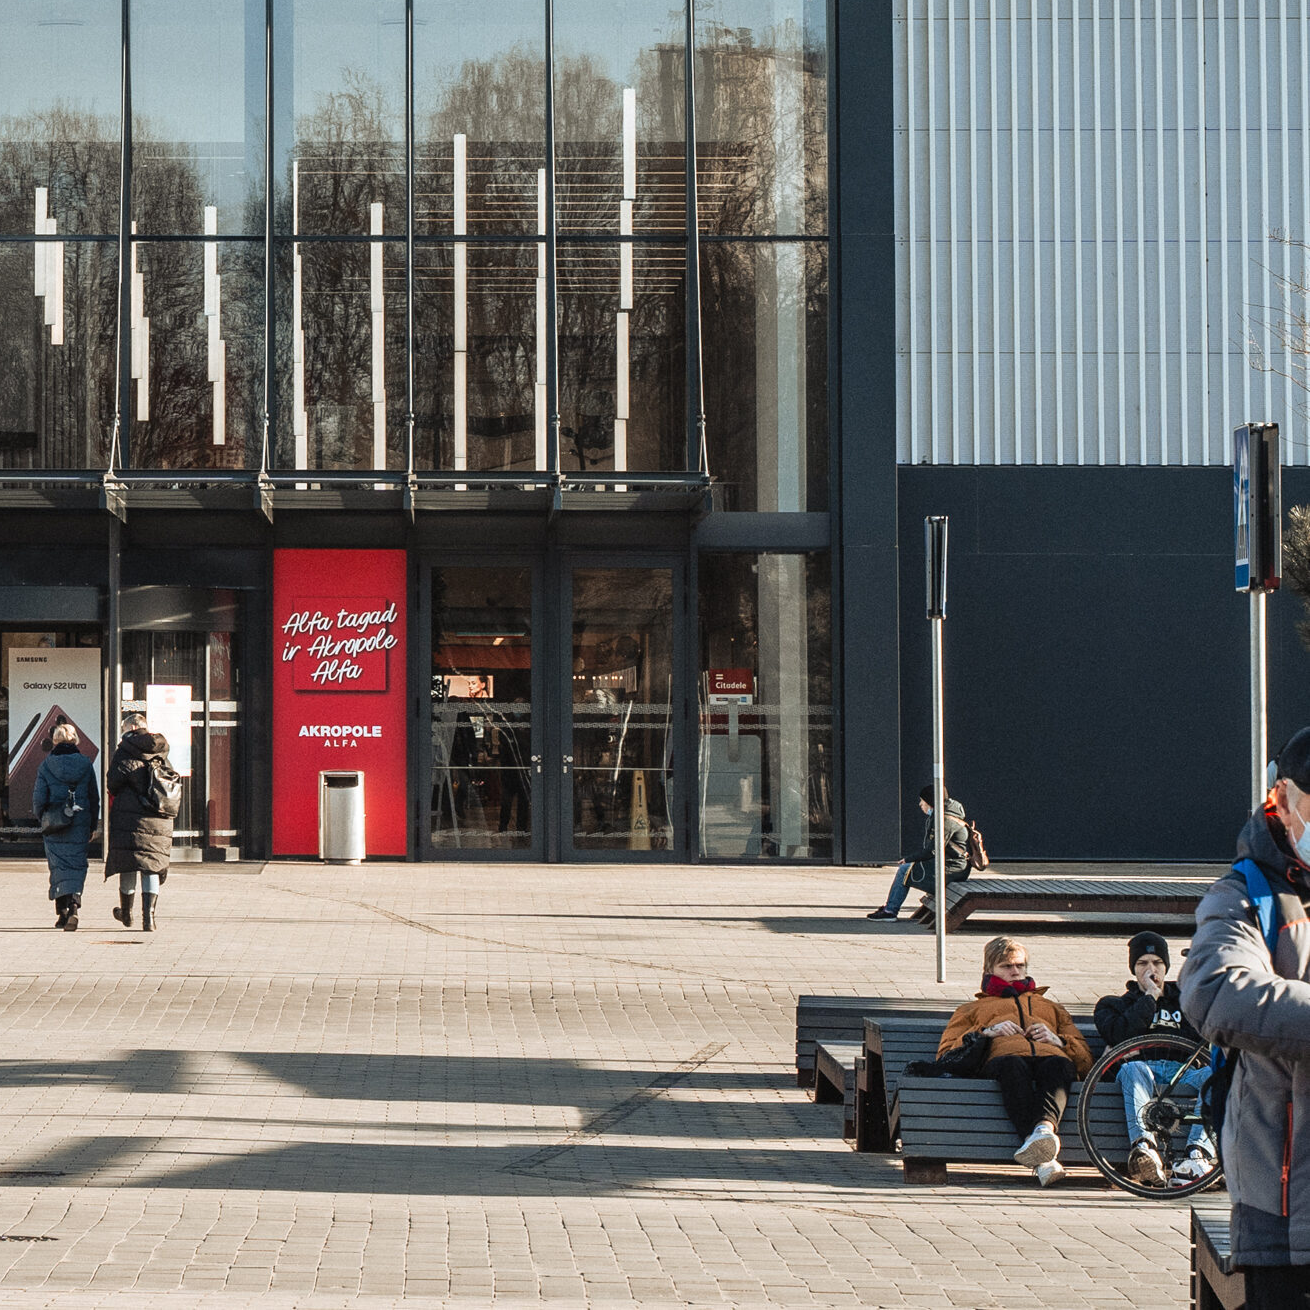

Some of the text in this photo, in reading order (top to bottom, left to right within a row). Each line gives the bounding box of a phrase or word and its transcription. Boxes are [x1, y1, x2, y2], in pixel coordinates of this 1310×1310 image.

[281, 602, 398, 637] Alfa tagad
[282, 627, 398, 662] ir Akropole
[310, 658, 363, 685] Alfa
[23, 682, 87, 691] Galaxy S22 Ultra
[298, 725, 382, 737] AKROPOLE
